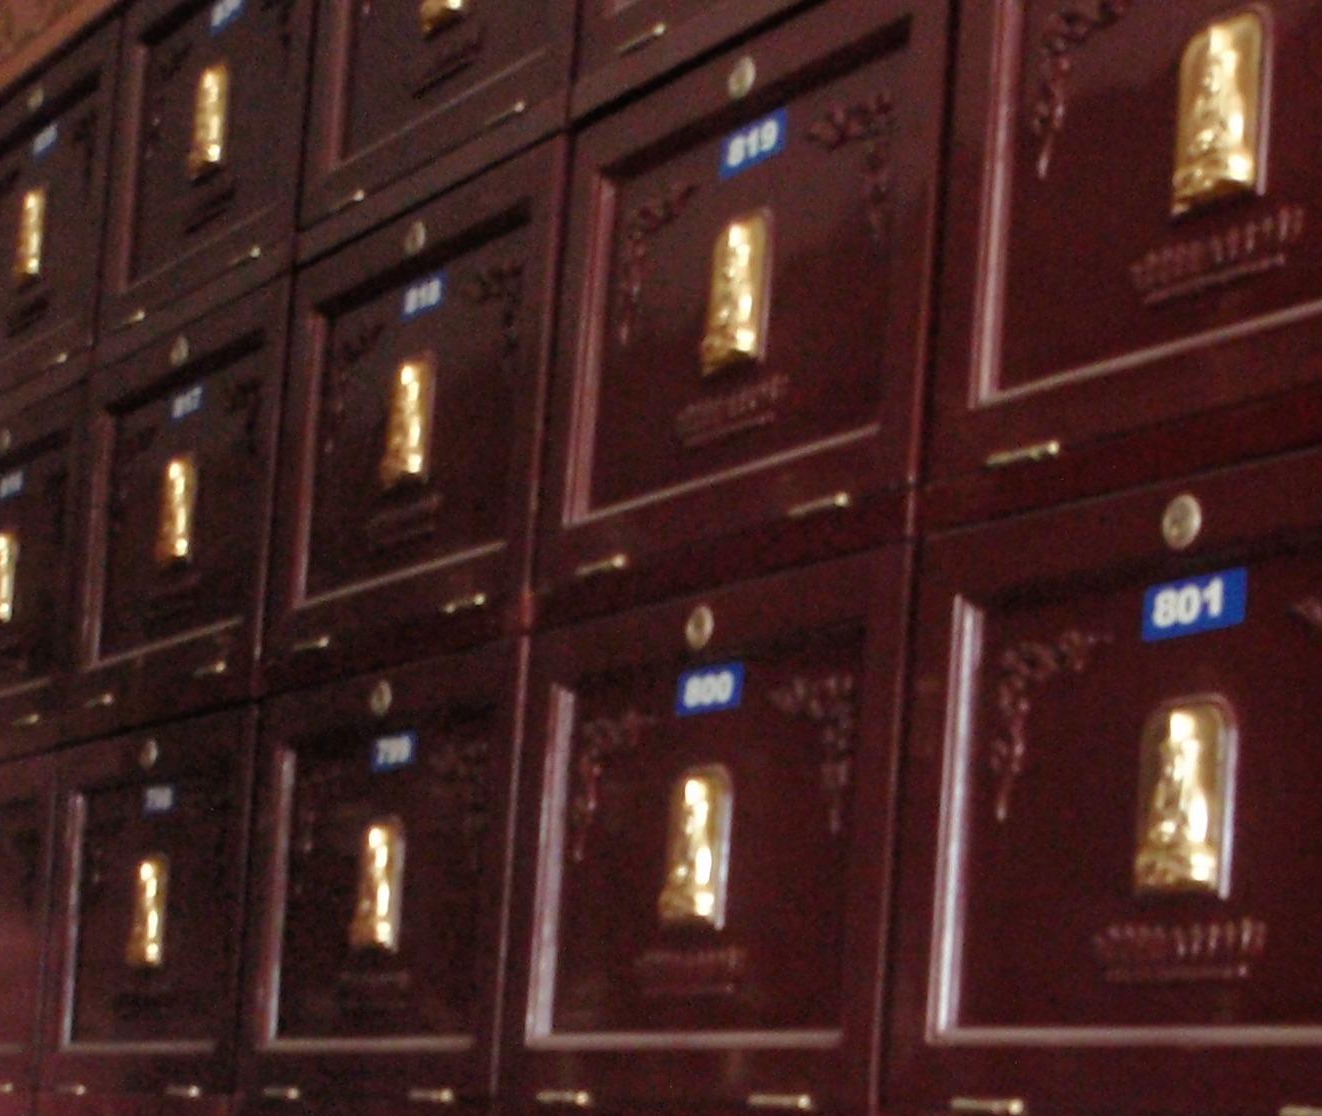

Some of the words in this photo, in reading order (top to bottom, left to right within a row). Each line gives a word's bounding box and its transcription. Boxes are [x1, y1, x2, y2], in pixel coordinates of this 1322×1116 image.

[725, 117, 779, 168] 819
[1150, 577, 1224, 630] 801
[681, 670, 735, 710] 800
